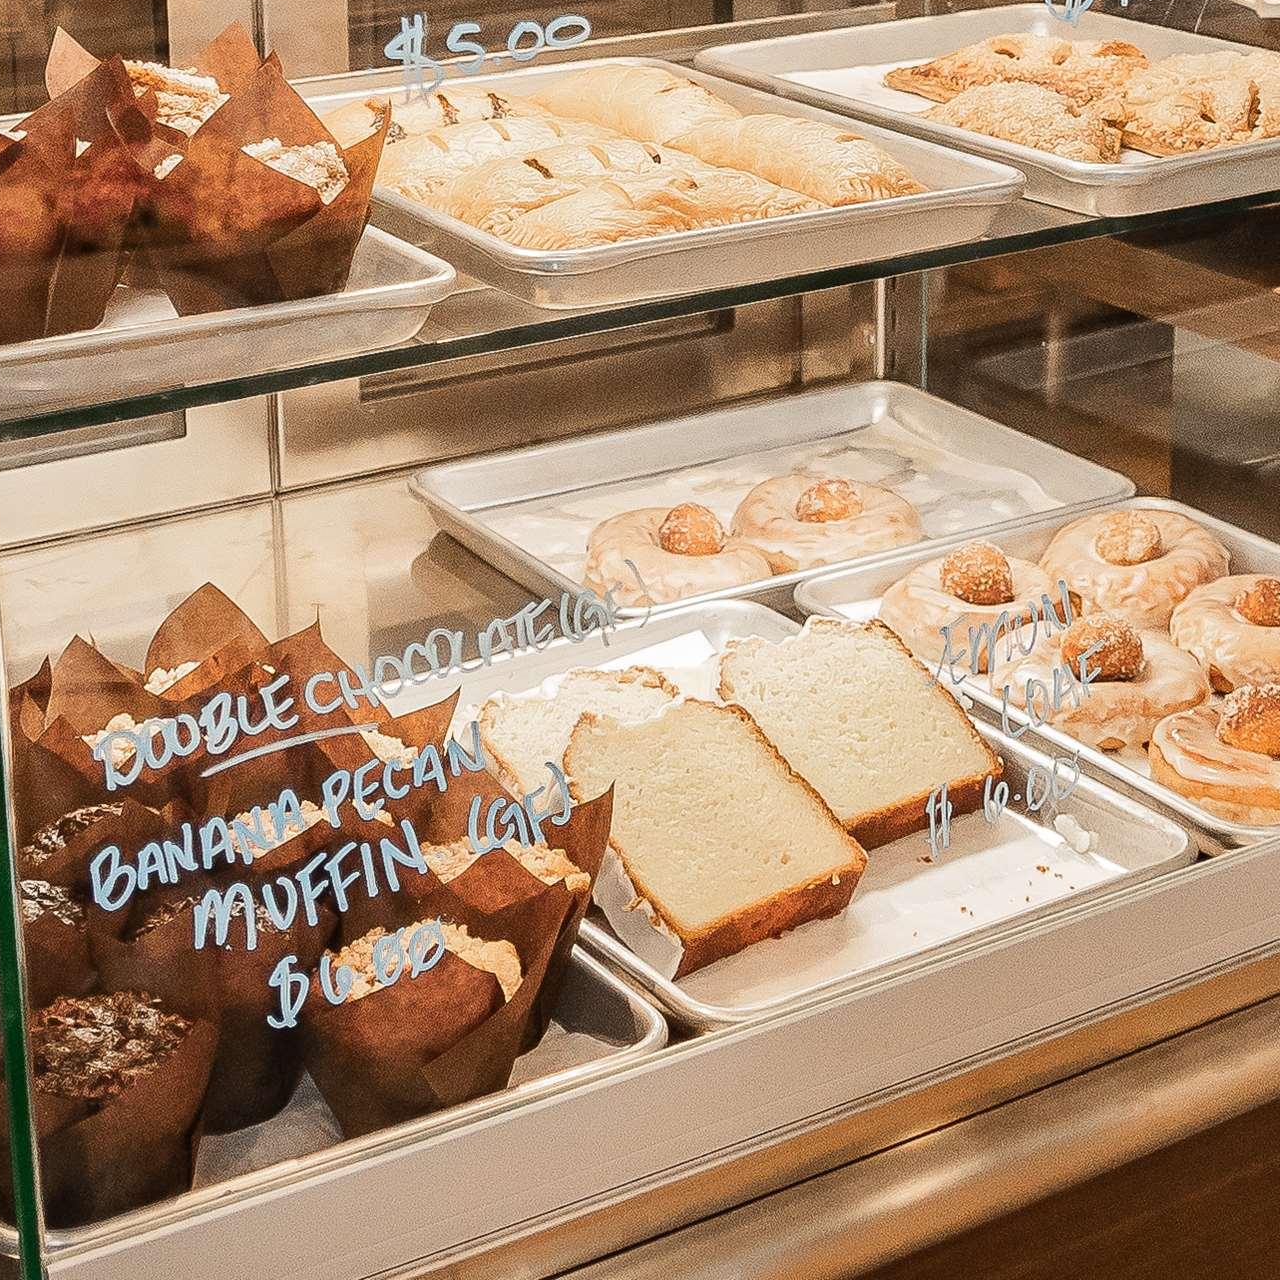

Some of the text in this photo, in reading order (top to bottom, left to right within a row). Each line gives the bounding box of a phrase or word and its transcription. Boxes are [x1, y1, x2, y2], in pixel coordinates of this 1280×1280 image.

[384, 13, 593, 95] $5.00
[95, 674, 299, 791] DOUBLE
[89, 720, 487, 912] BANANA PECAN
[193, 819, 428, 952] MUFFIN
